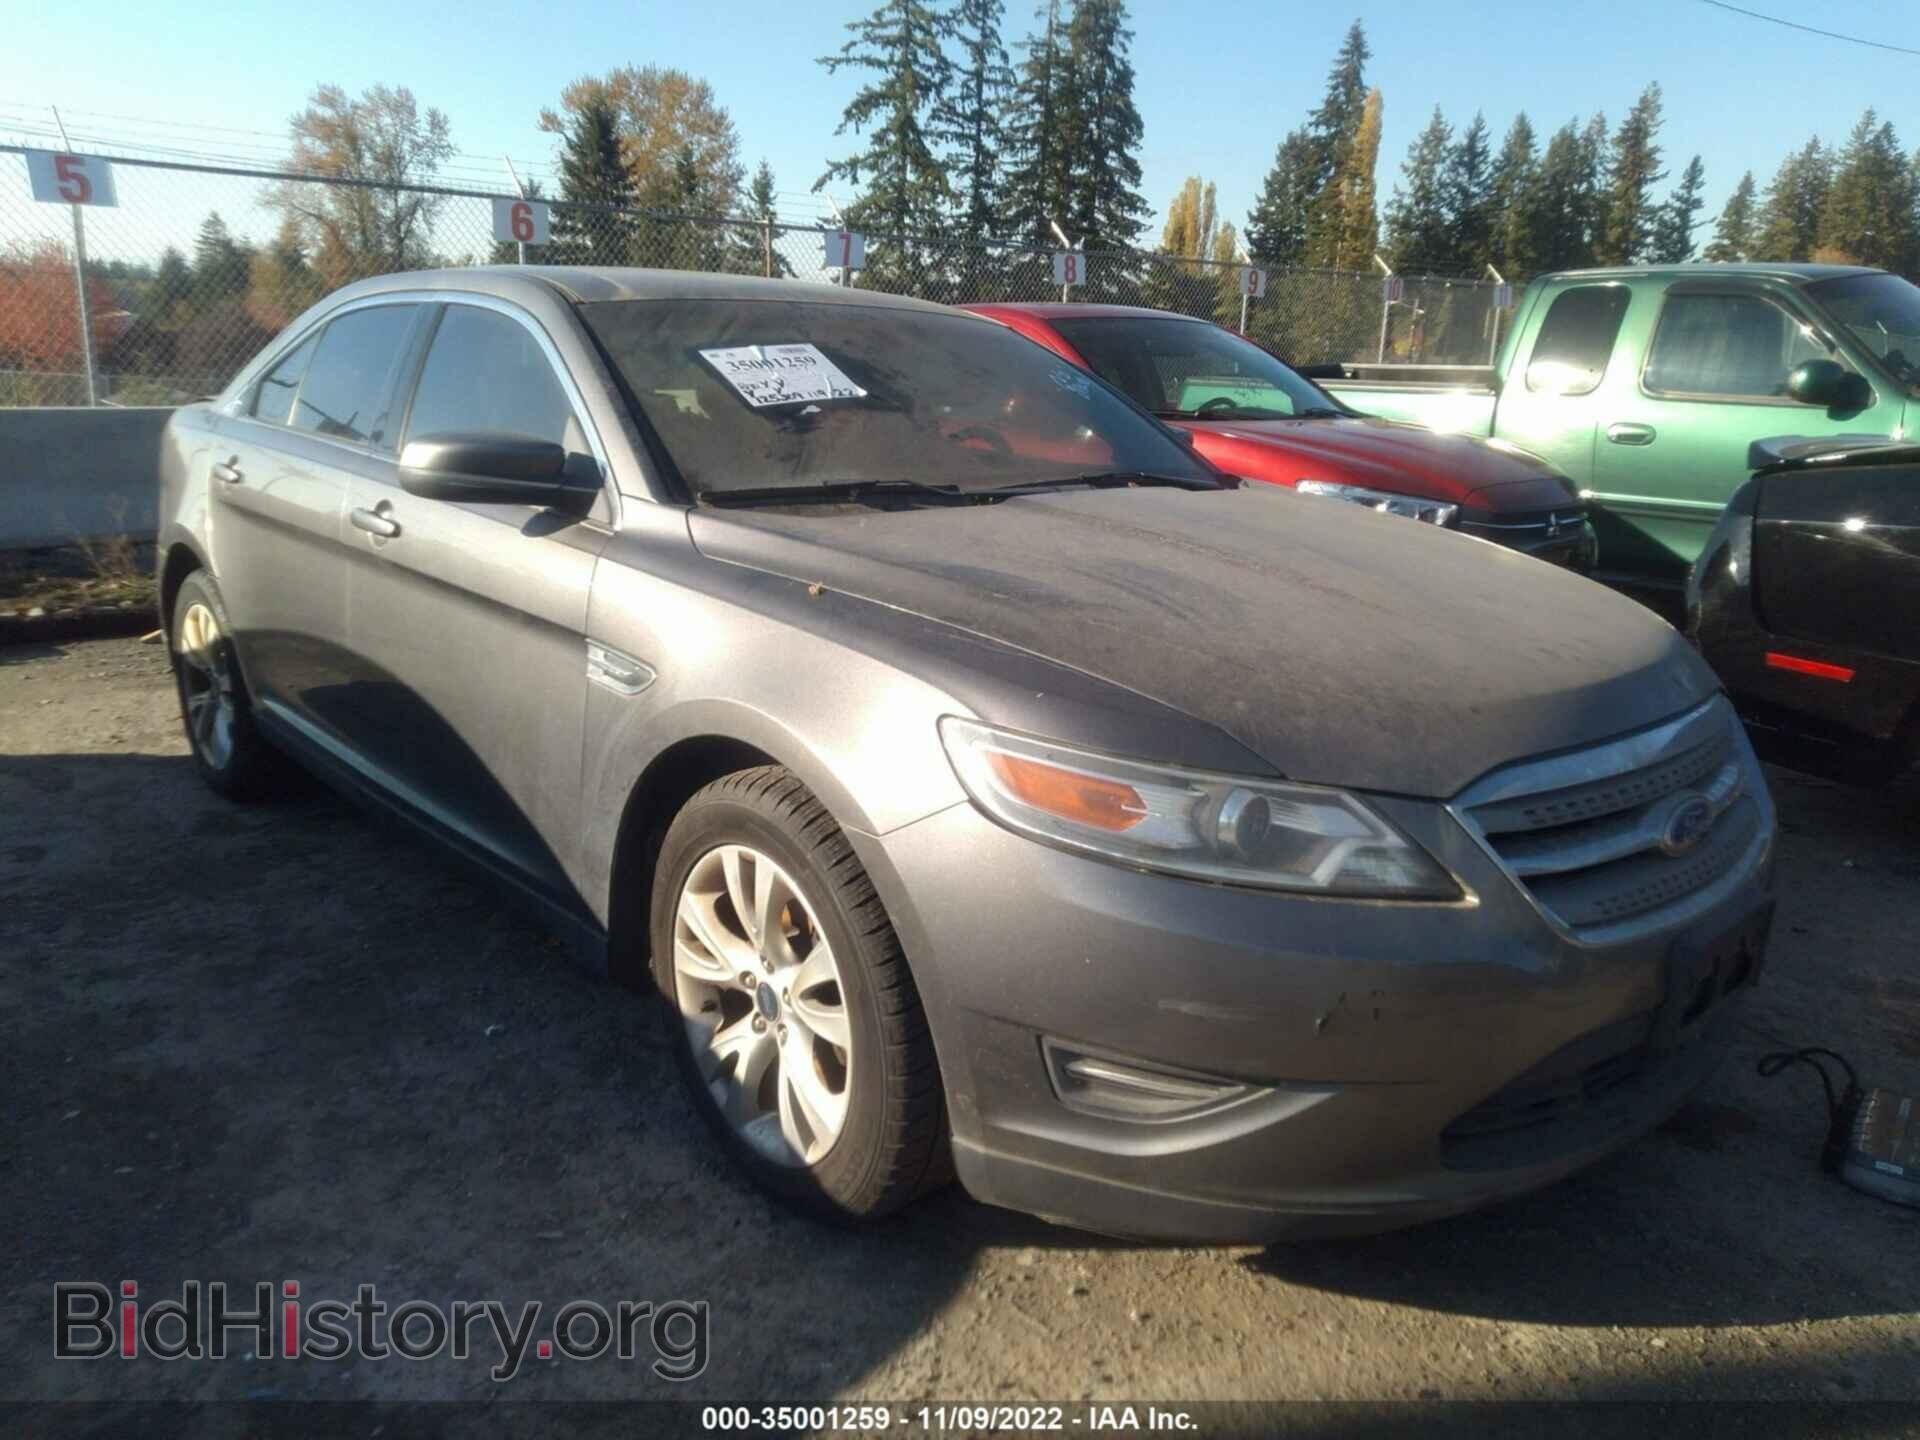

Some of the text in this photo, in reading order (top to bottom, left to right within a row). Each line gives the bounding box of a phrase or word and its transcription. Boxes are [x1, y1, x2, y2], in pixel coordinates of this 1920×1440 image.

[54, 155, 92, 203] 5
[511, 202, 534, 241] 6
[838, 233, 852, 266] 7
[1064, 255, 1077, 283] 8
[1248, 270, 1258, 294] 9
[726, 356, 817, 370] 35001259
